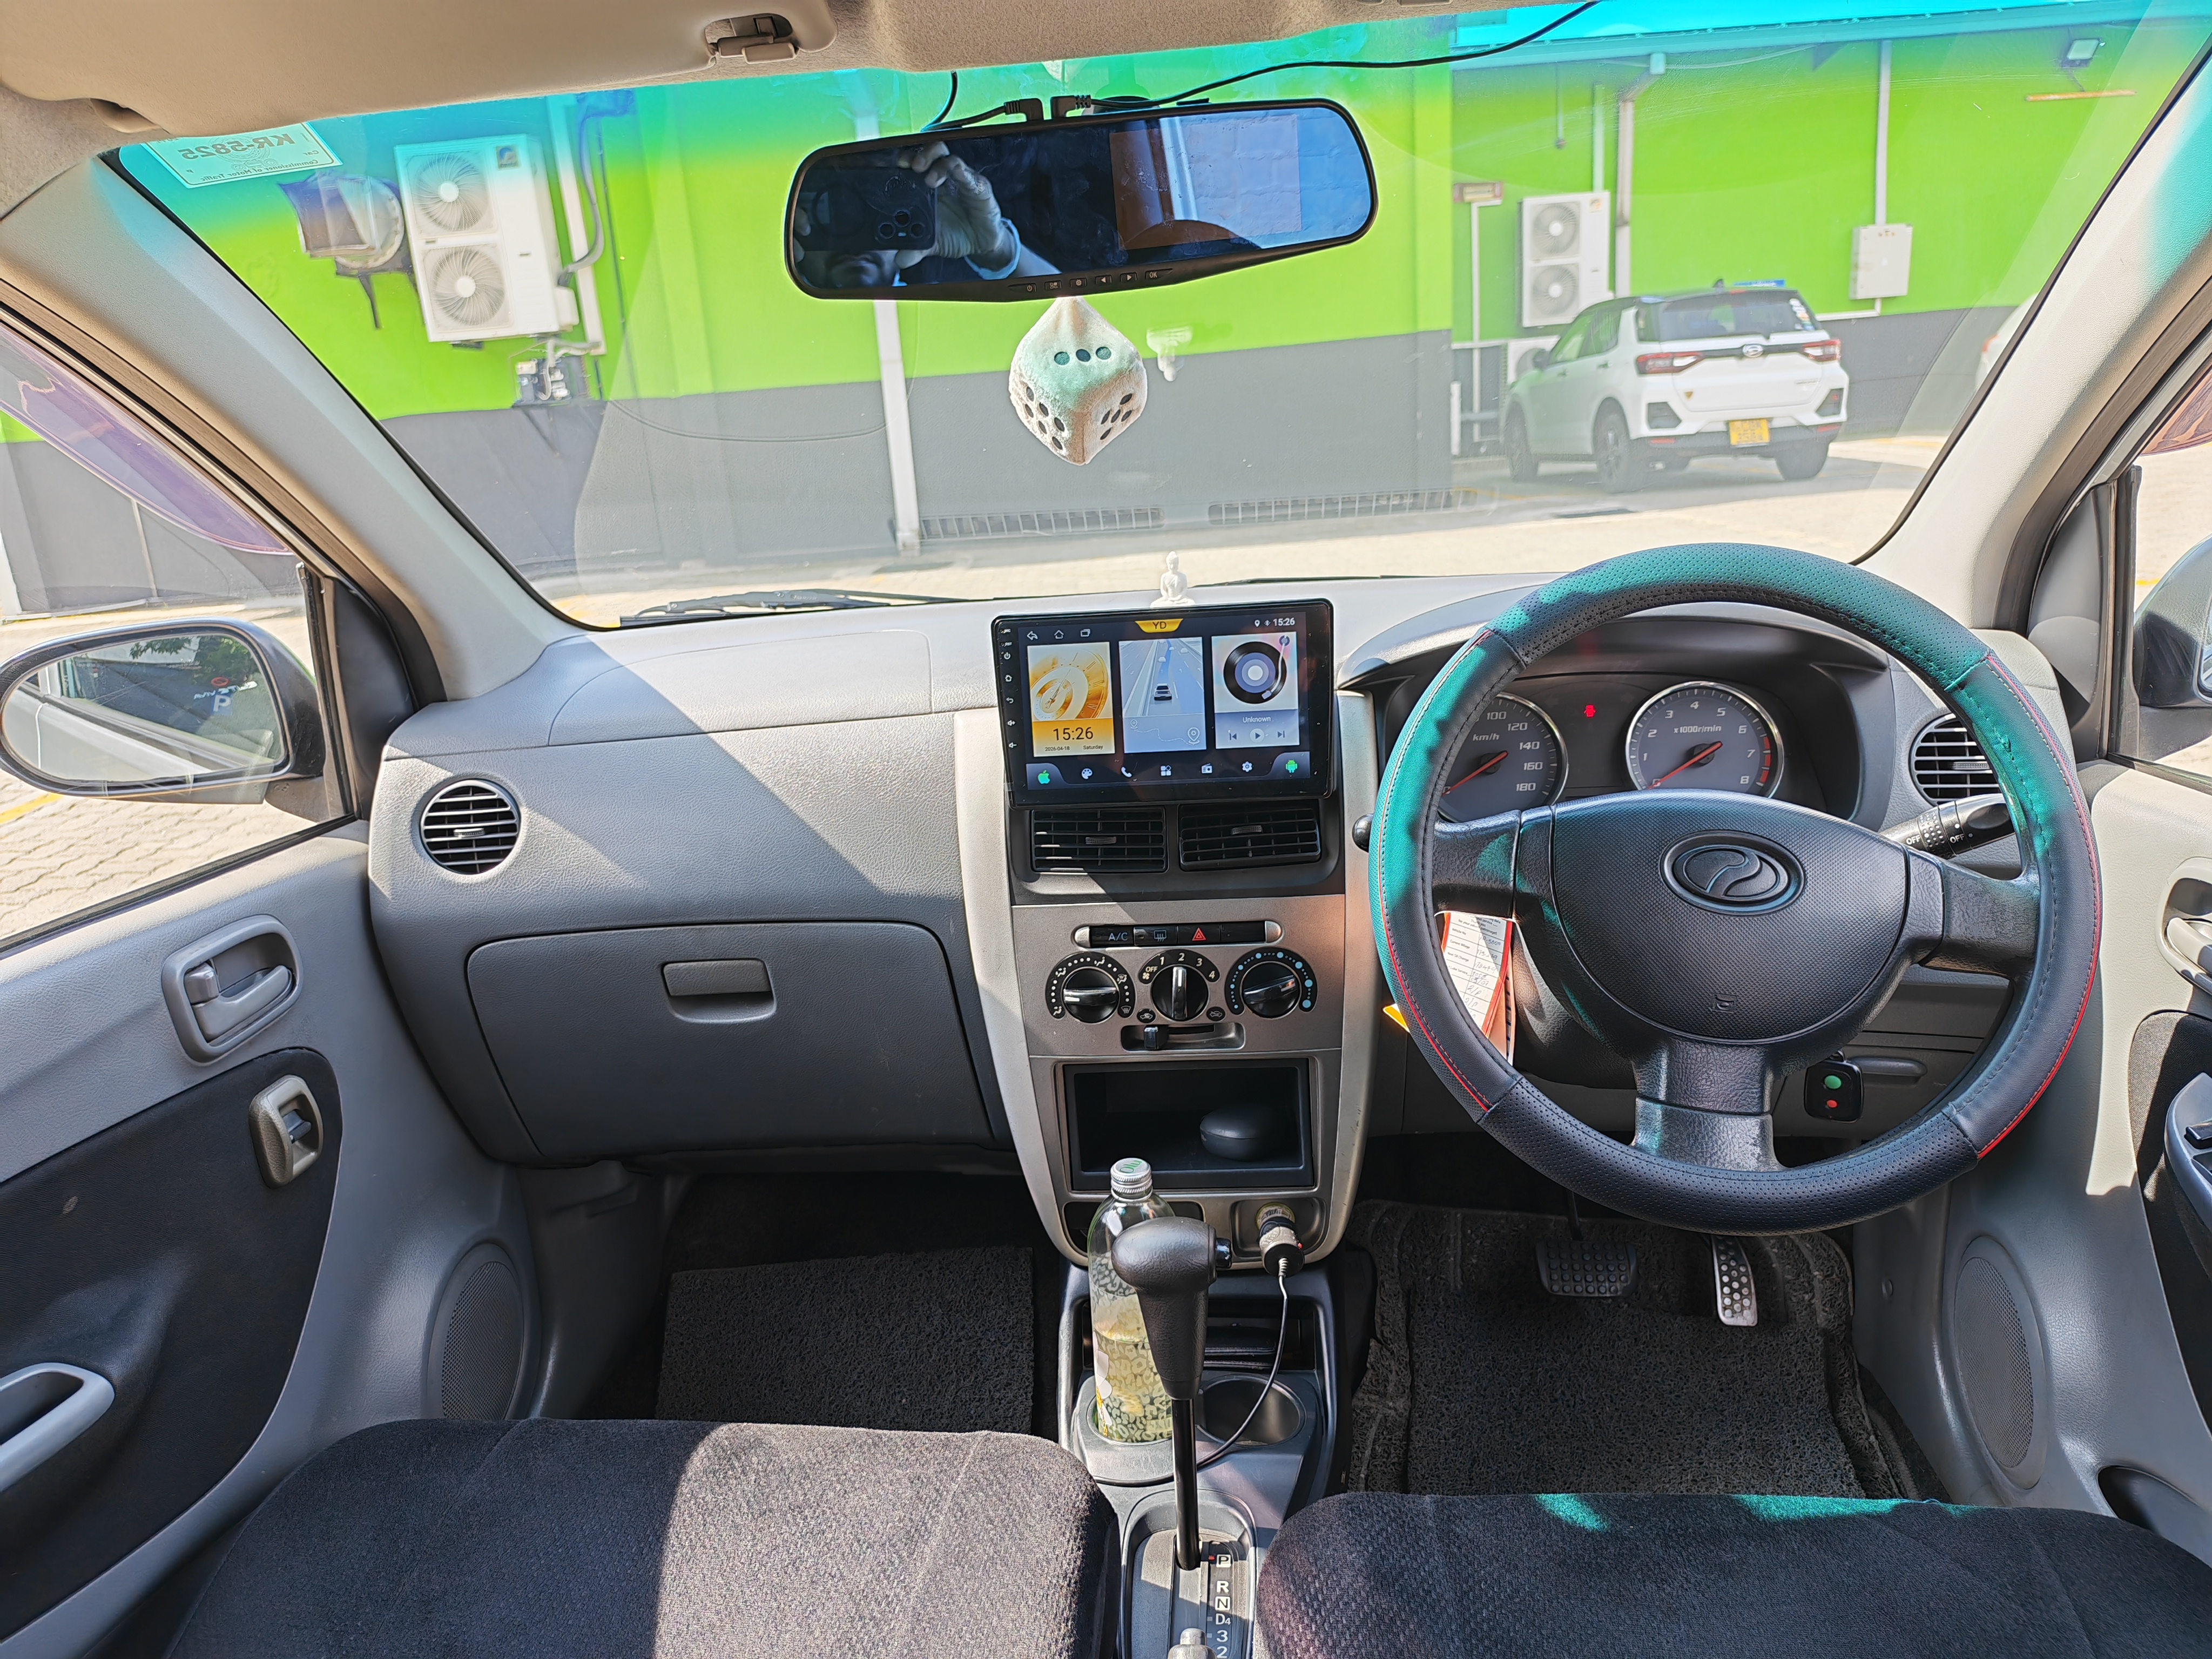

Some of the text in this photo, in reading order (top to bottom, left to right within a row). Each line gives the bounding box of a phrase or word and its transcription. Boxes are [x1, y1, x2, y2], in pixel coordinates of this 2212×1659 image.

[1152, 622, 1167, 630] YD
[1273, 618, 1295, 626] 15:26
[213, 694, 231, 712] P
[1487, 711, 1507, 720] 100
[1665, 710, 1674, 718] 3
[1716, 707, 1726, 716] 5
[1507, 723, 1528, 731] 120
[1738, 725, 1747, 733] 6
[1053, 727, 1093, 740] 15:26
[1473, 733, 1499, 741] km/h
[1648, 729, 1657, 737] 2
[1519, 741, 1540, 750] 140
[1643, 753, 1648, 761] 1
[1746, 750, 1755, 758] 7
[1523, 762, 1543, 770] 160
[1740, 775, 1749, 784] 8
[1516, 783, 1536, 791] 180
[1906, 835, 1920, 845] OFF
[1950, 834, 1965, 844] OFF
[1108, 932, 1128, 941] A/C
[1160, 956, 1164, 965] 1
[1178, 953, 1185, 961] 2
[1196, 958, 1203, 966] 3
[1209, 970, 1215, 979] 4
[1218, 1556, 1229, 1565] P
[1216, 1580, 1229, 1593] R
[1217, 1598, 1229, 1609] N
[1216, 1613, 1231, 1626] D4
[1216, 1630, 1228, 1642] 3
[1217, 1646, 1228, 1658] 2
